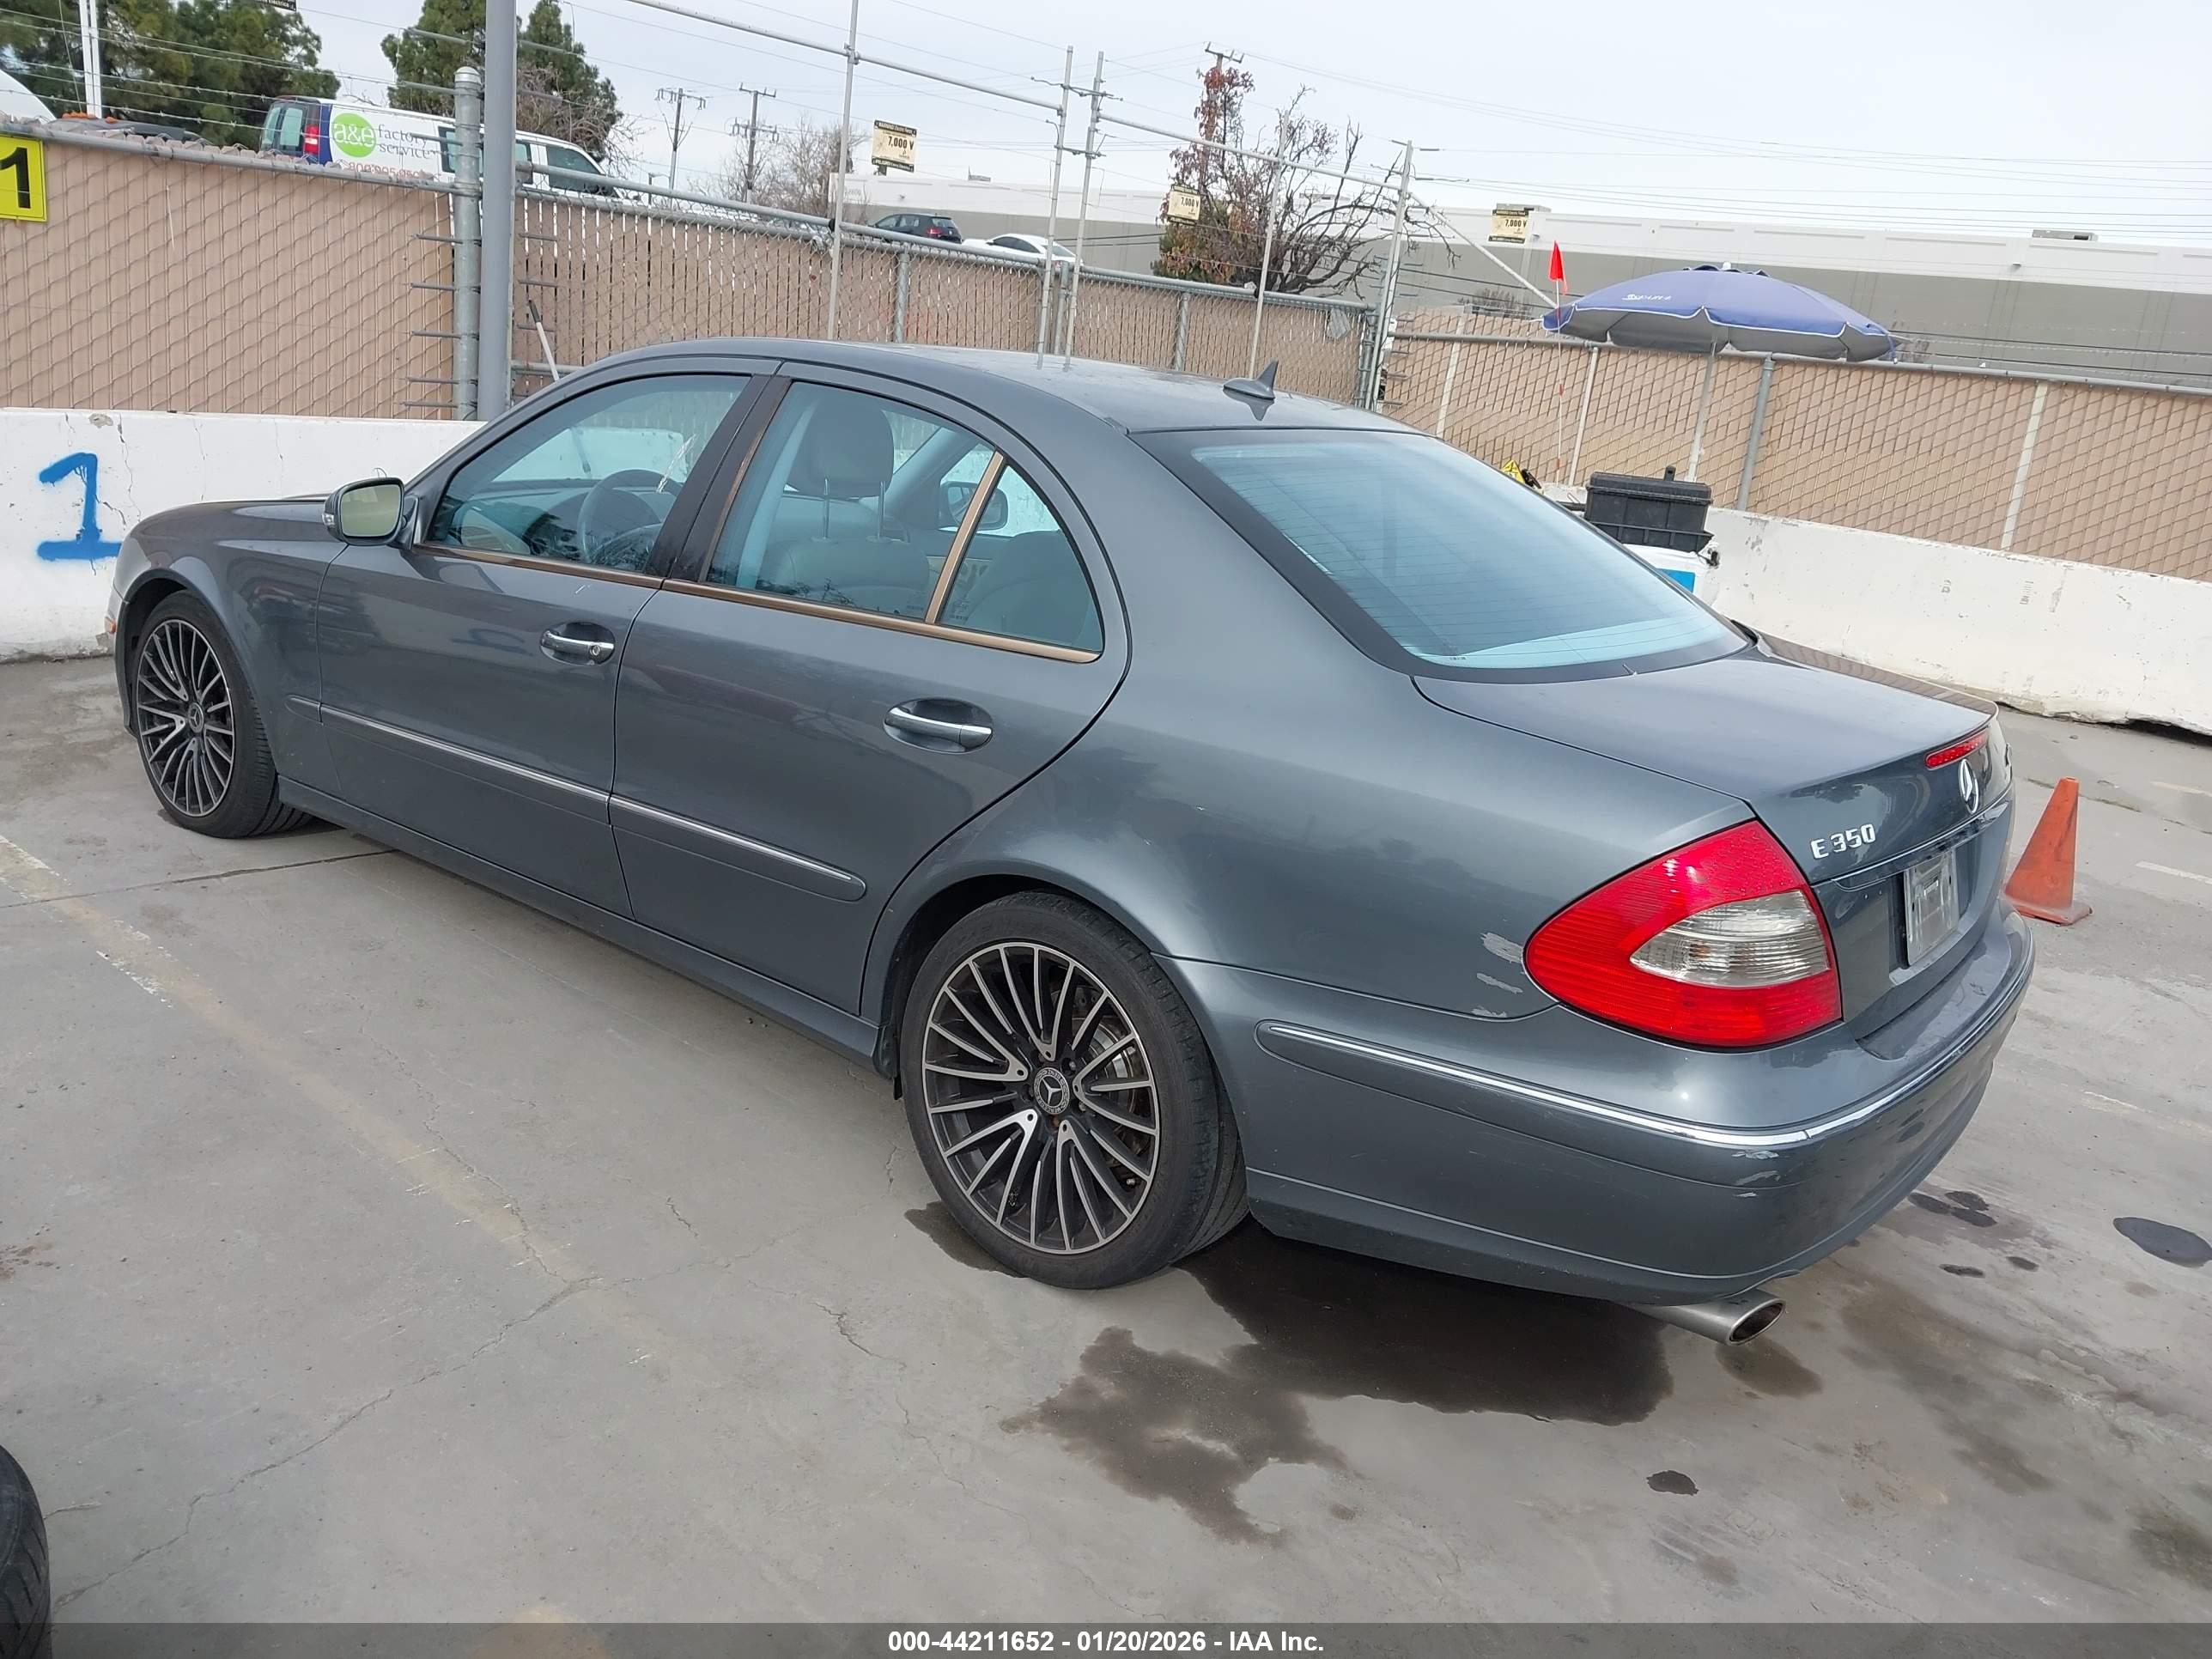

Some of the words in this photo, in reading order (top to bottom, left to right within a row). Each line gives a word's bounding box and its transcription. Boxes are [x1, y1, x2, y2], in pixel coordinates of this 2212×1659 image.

[334, 123, 374, 148] a&e
[379, 124, 426, 150] factory
[888, 137, 908, 149] 7,000
[909, 140, 914, 150] V
[1182, 197, 1194, 207] 7,000
[1505, 219, 1522, 228] 7,000
[38, 452, 122, 562] 1
[1810, 838, 1830, 859] E
[1830, 823, 1876, 853] 350
